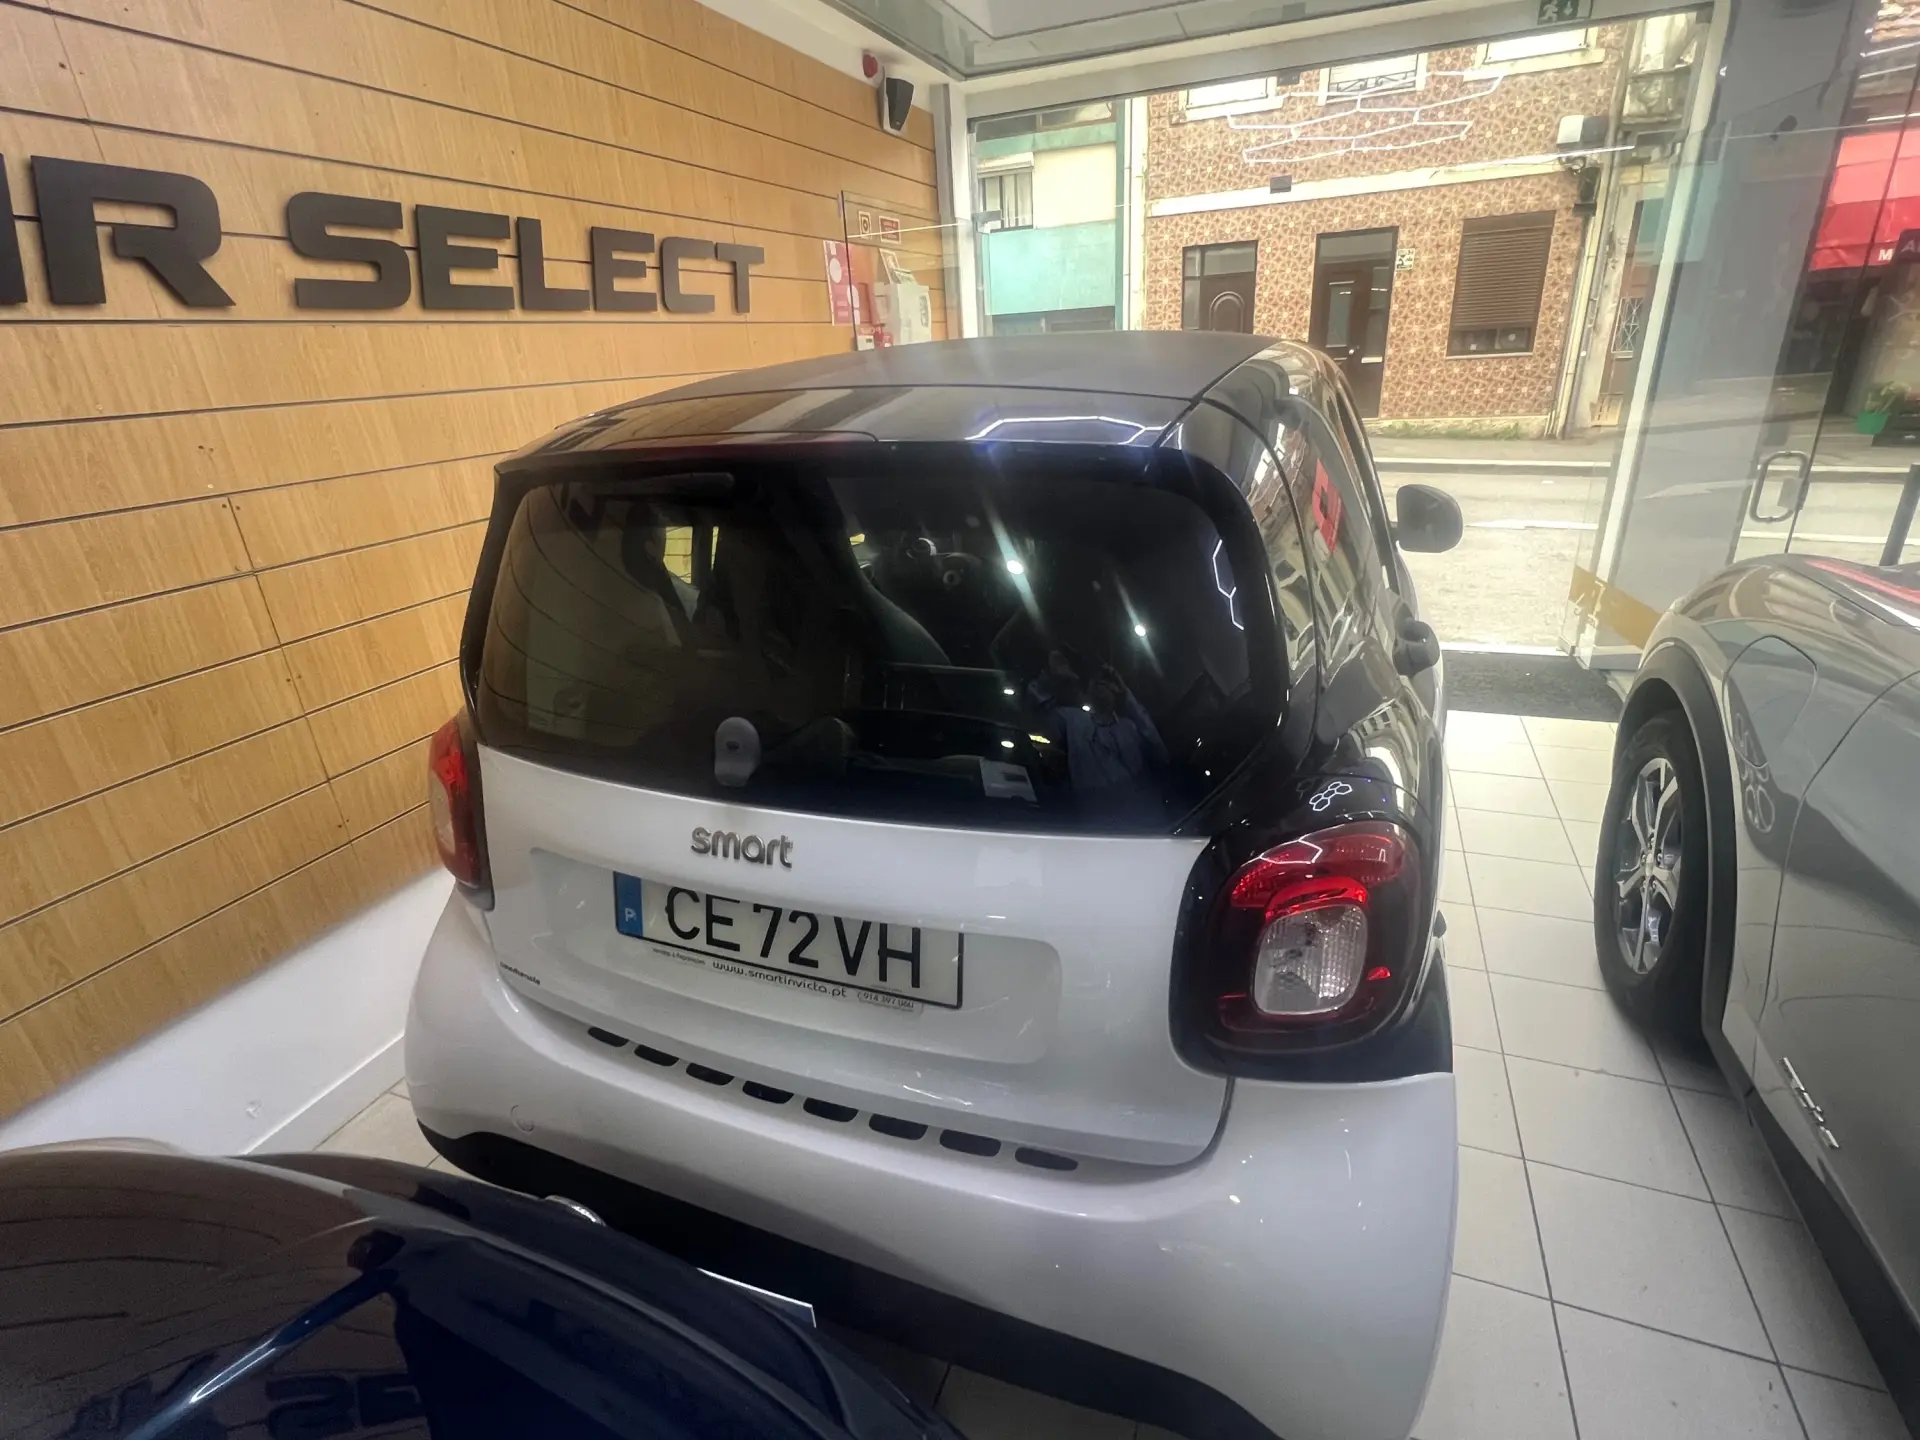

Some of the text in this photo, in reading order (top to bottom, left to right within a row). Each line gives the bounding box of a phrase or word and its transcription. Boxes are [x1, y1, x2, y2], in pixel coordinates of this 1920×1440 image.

[288, 192, 765, 313] SELECT
[690, 826, 794, 869] smart
[665, 886, 921, 989] CE 72 VH
[712, 960, 848, 998] www.smartinvicta.pt
